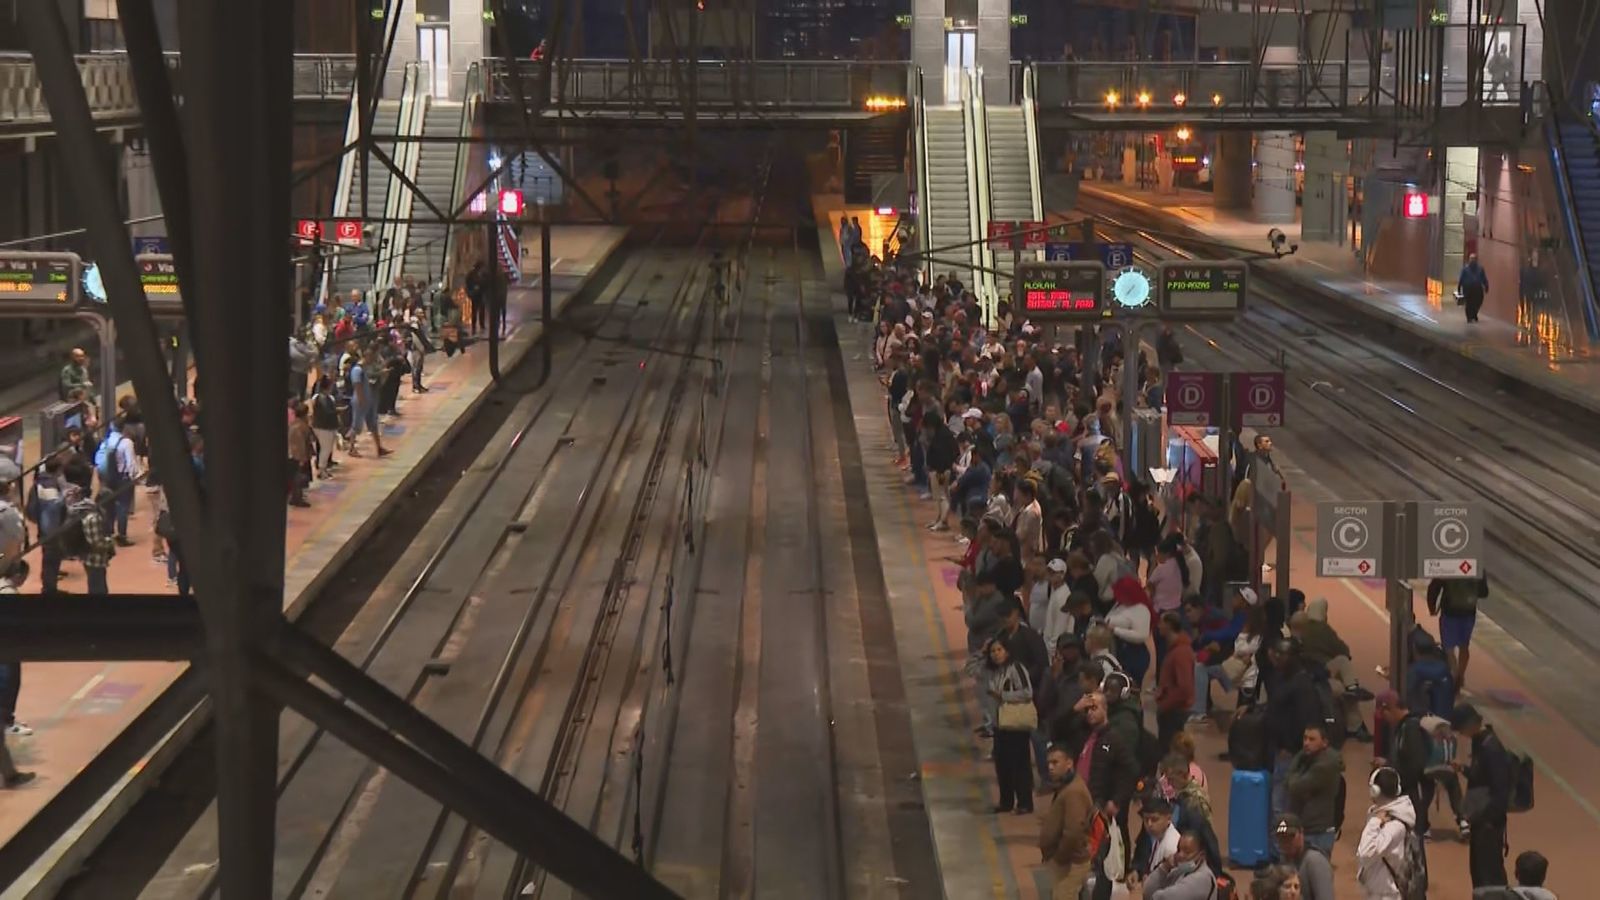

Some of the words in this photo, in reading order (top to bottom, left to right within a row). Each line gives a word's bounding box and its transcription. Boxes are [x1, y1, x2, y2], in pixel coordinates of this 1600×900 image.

[1063, 270, 1069, 279] 3
[1204, 270, 1211, 279] 4
[1184, 387, 1200, 405] D
[1255, 388, 1271, 406] D
[1334, 506, 1368, 516] SECTOR
[1434, 508, 1468, 516] SECTOR
[1340, 523, 1361, 548] C
[1440, 523, 1461, 548] C
